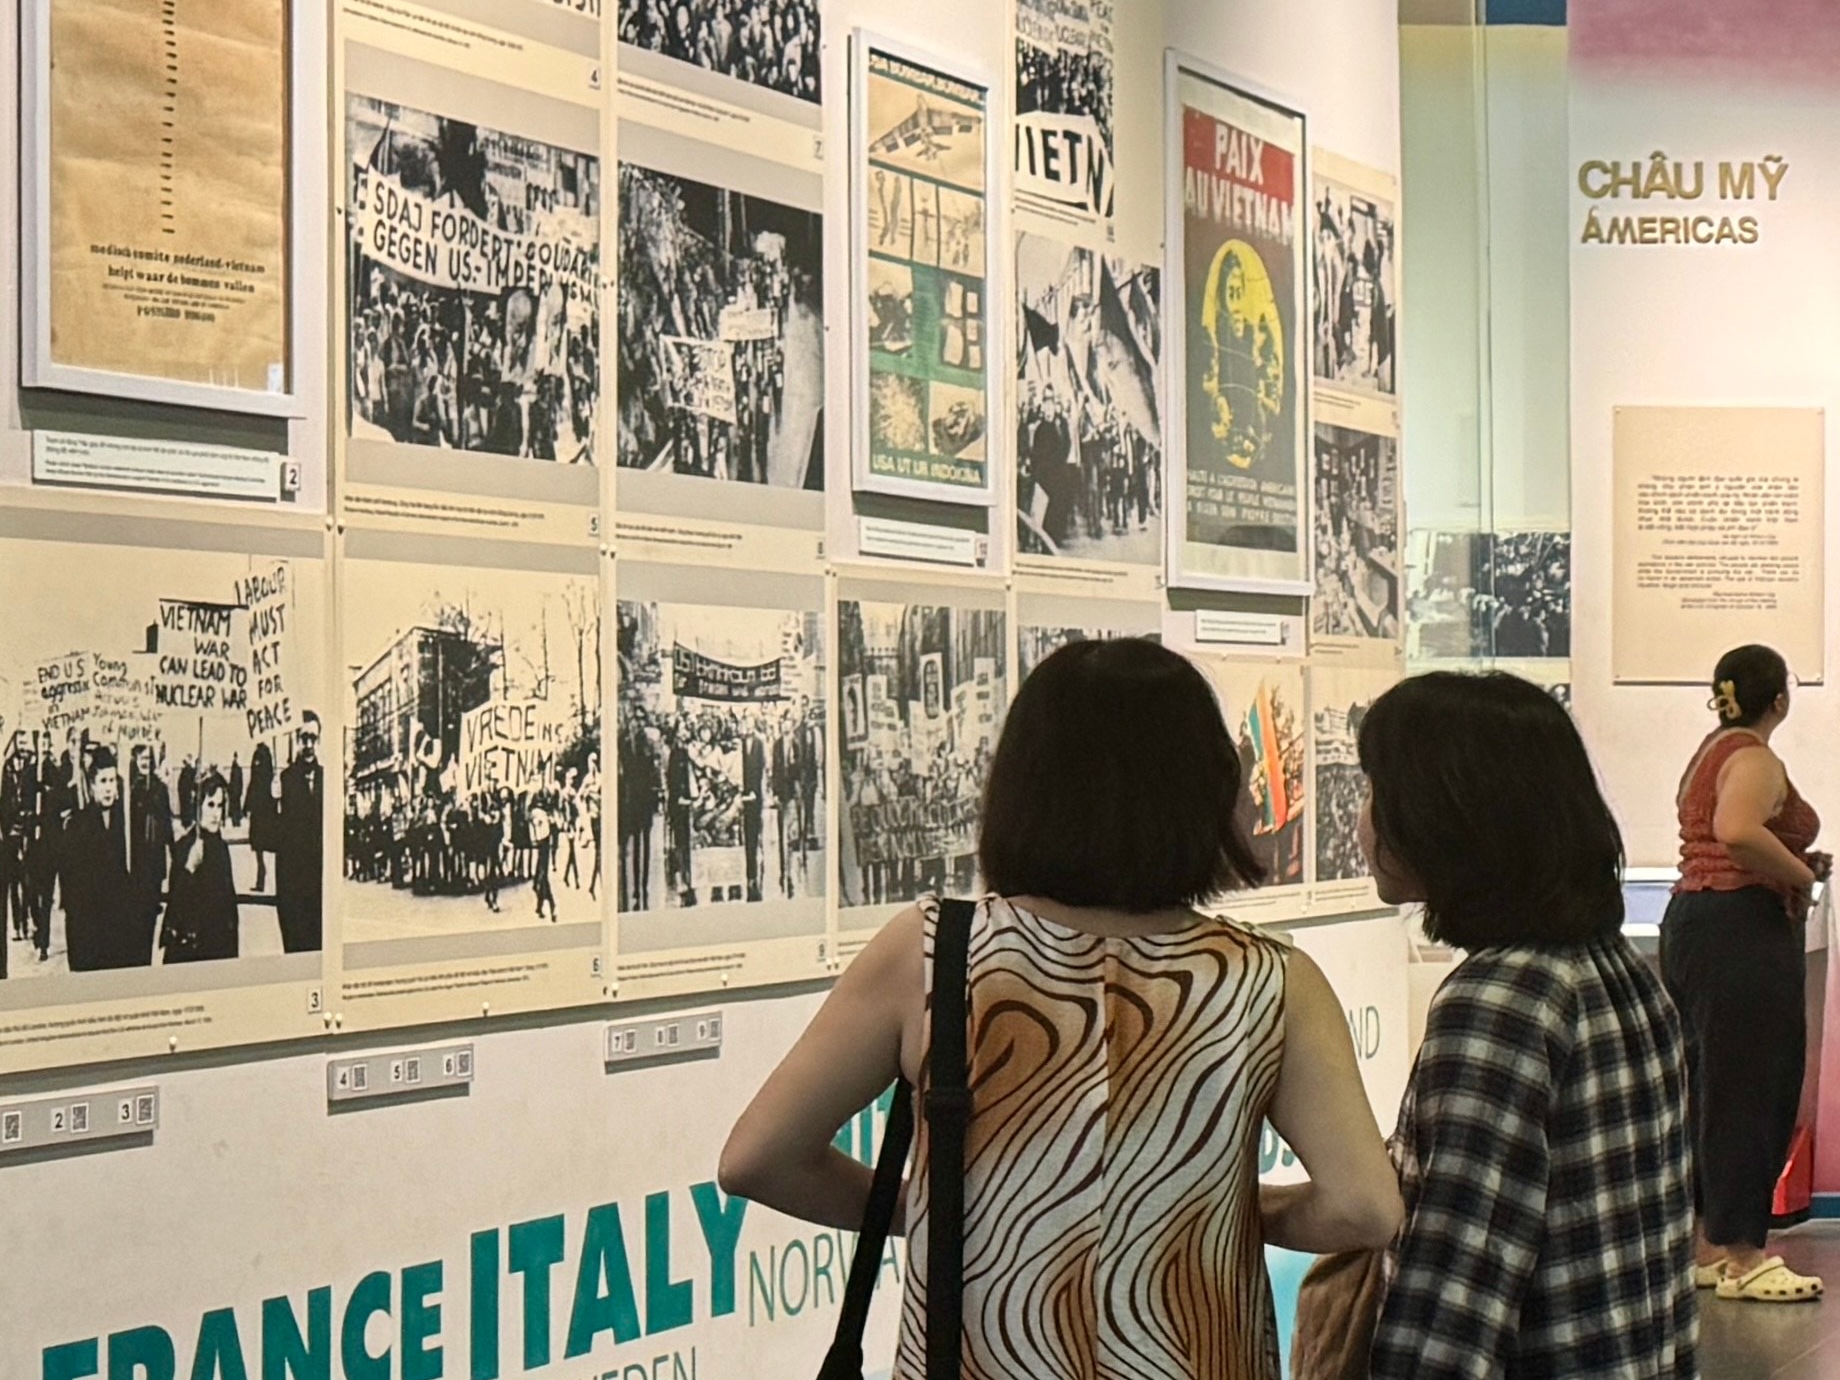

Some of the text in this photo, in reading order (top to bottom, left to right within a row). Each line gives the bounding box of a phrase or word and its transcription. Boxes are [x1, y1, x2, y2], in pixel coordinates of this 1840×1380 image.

[1216, 122, 1264, 185] PAIX
[1578, 150, 1789, 200] CHÂU MỸ
[1185, 166, 1295, 246] AU VIETNAM
[374, 219, 438, 276] GEGEN
[136, 271, 165, 283] waar
[224, 281, 255, 293] vallen
[289, 469, 298, 485] 2
[590, 517, 598, 532] 5
[234, 566, 286, 606] LABOUR
[160, 604, 230, 637] VIETNAM
[250, 604, 285, 645] MUST
[194, 637, 229, 661] WAR
[252, 641, 280, 675] ACT
[38, 666, 59, 684] END
[159, 656, 247, 687] CAN LEAD TO
[258, 673, 283, 699] FOR
[155, 684, 247, 710] NUCLEAR WAR
[42, 707, 91, 732] VIETNAM
[247, 698, 292, 739] PEACE
[467, 704, 536, 753] VREDE
[311, 991, 319, 1008] 3
[339, 1072, 348, 1085] 4
[394, 1064, 400, 1079] 5
[56, 1103, 129, 1131] 2 3
